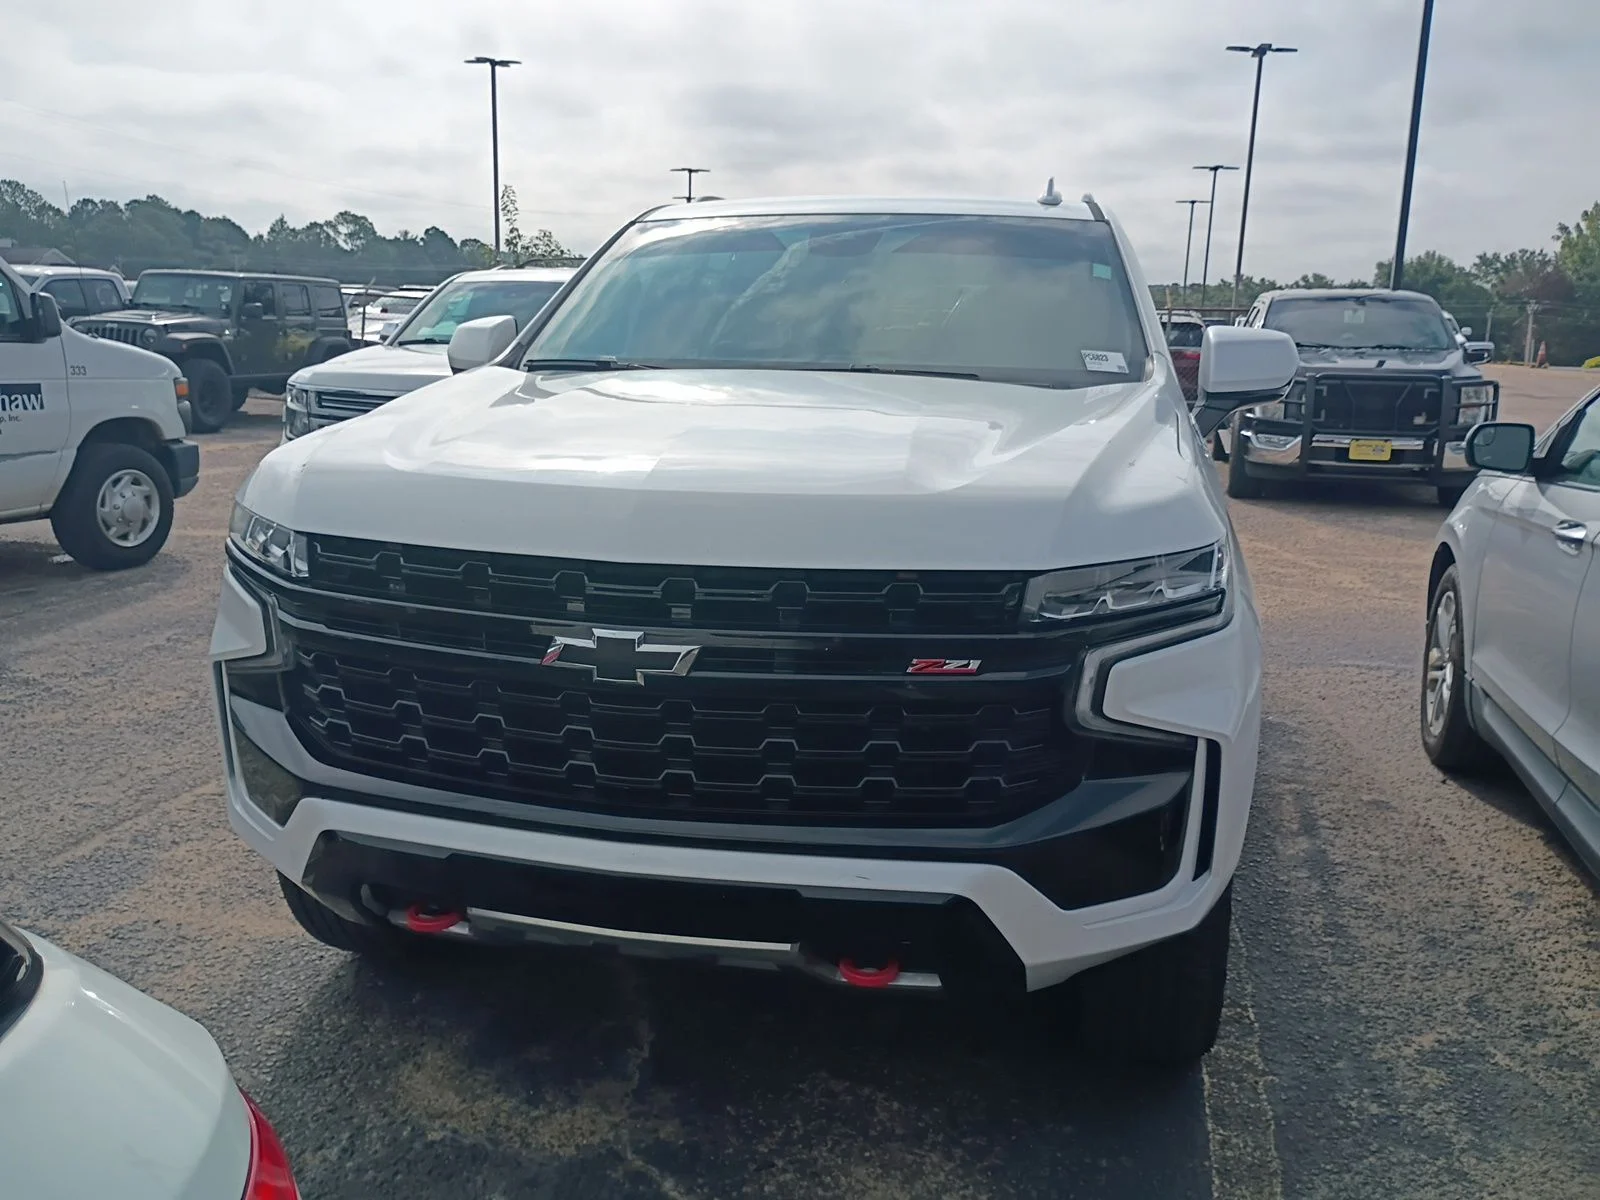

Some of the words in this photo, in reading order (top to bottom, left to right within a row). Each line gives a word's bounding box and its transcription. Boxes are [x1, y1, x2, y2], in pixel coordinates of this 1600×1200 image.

[70, 365, 87, 376] 333
[8, 414, 23, 423] Inc.
[906, 658, 982, 674] Z71
